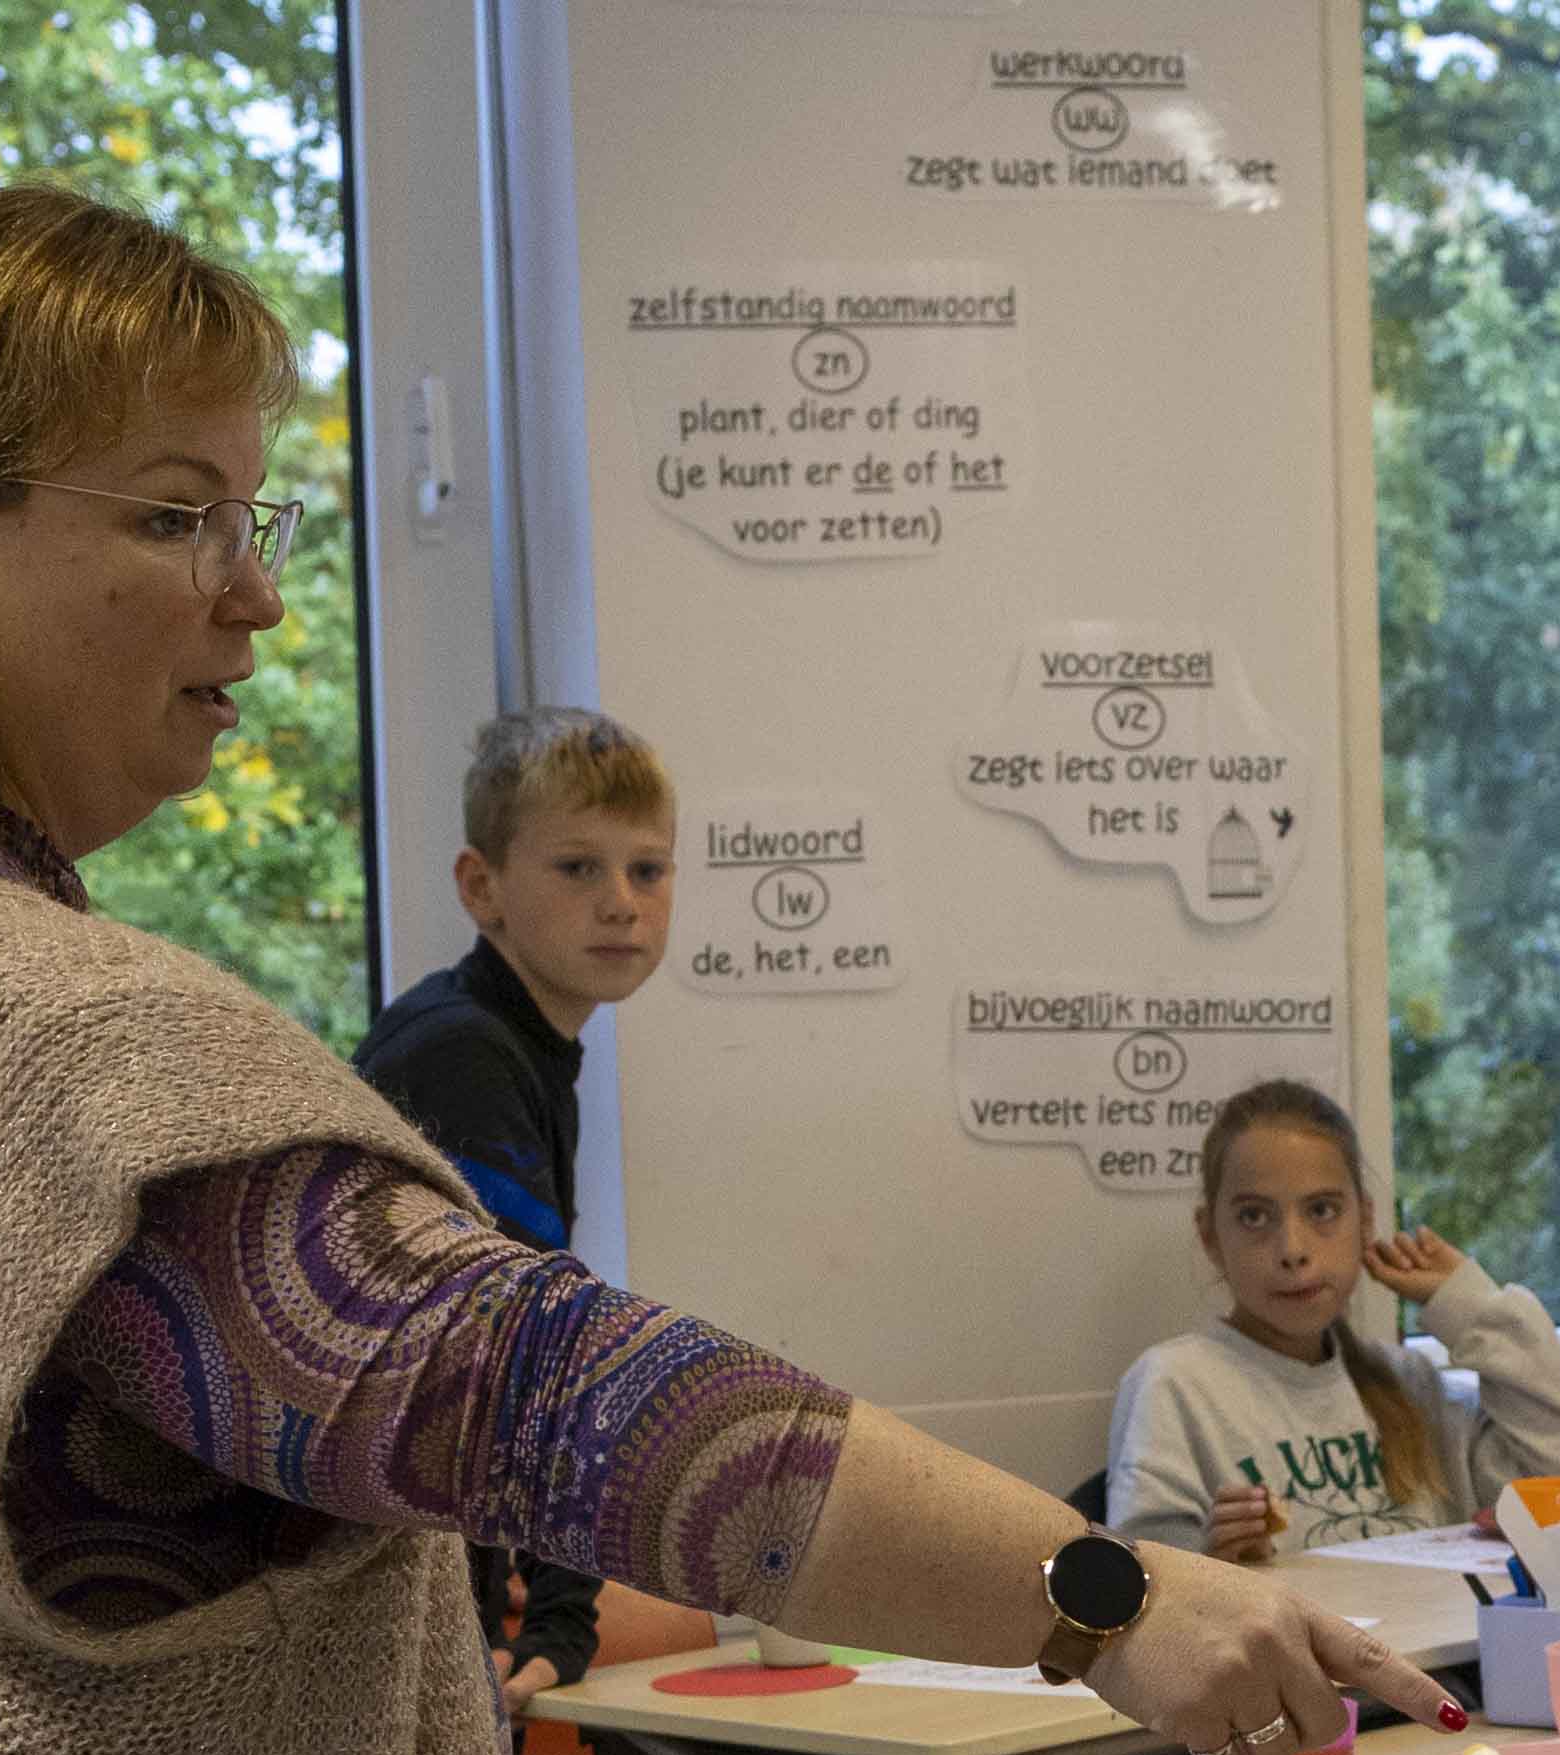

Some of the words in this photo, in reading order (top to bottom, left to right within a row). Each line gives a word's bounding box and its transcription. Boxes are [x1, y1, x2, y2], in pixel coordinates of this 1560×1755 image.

[1064, 108, 1120, 134] ww
[906, 156, 981, 190] zegt
[993, 157, 1055, 186] wat
[1068, 153, 1187, 186] iemand
[629, 287, 825, 324] zelfstandig
[837, 286, 1016, 320] naamwoord
[814, 352, 851, 377] zn
[679, 401, 777, 441] plant,
[788, 400, 855, 431] dier
[867, 398, 900, 431] of
[914, 399, 980, 438] ding
[656, 453, 707, 498] (je
[719, 455, 791, 487] kunt
[805, 461, 842, 486] er
[853, 455, 892, 484] de
[904, 451, 938, 484] of
[950, 452, 1005, 482] het
[733, 517, 806, 543] voor
[820, 505, 943, 543] zetten)
[1040, 650, 1214, 679] voorzetsel
[969, 754, 1043, 788] zegt
[1055, 751, 1114, 783] iets
[1126, 755, 1198, 783] over
[1209, 755, 1288, 783] waar
[1089, 804, 1144, 834] het
[1155, 802, 1180, 834] is
[707, 817, 864, 858] lidwoord
[692, 942, 743, 979] de,
[755, 940, 822, 974] het,
[833, 943, 891, 969] een
[968, 991, 1134, 1030] bijvoeglijk
[1145, 995, 1332, 1026] naamwoord
[1132, 1044, 1172, 1077] bn
[970, 1099, 1088, 1128] vertelt
[1098, 1095, 1155, 1127] iets
[1099, 1149, 1155, 1176] een
